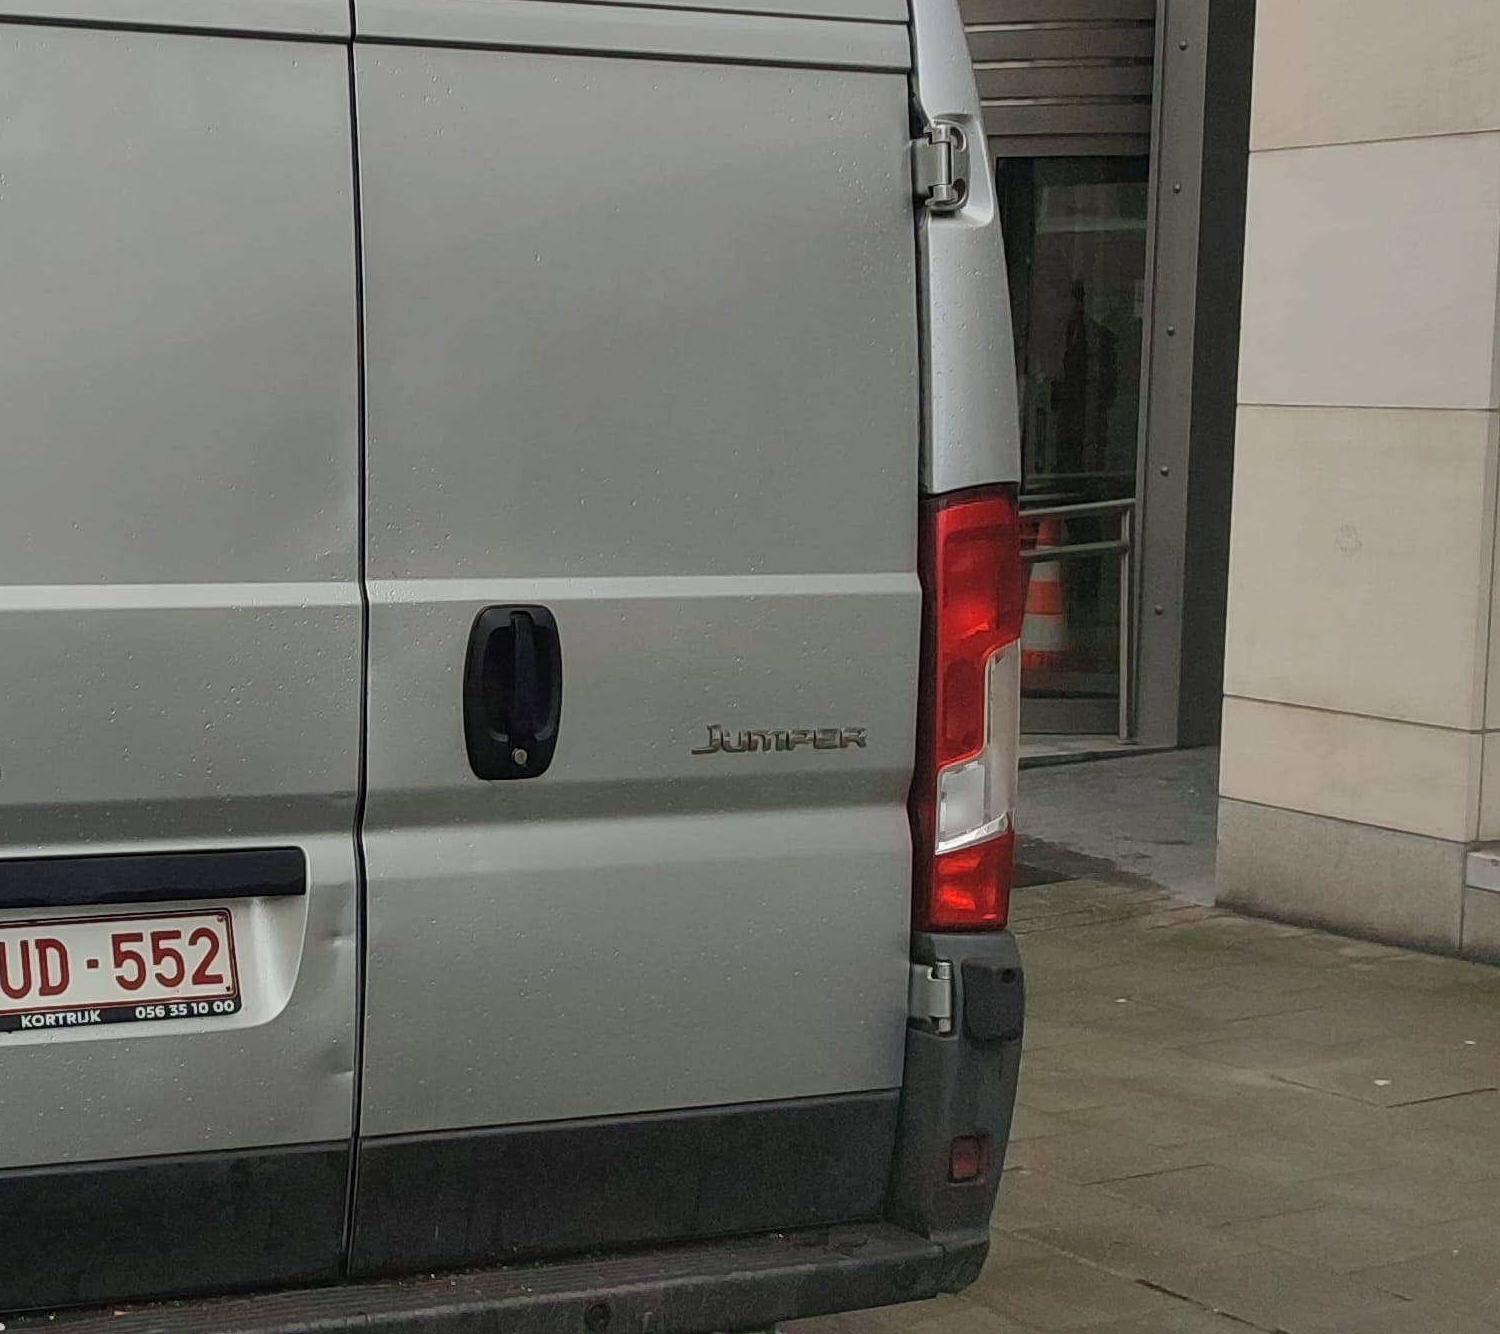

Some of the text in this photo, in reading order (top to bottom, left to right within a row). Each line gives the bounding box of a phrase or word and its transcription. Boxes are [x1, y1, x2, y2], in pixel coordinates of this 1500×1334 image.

[21, 1010, 101, 1028] KORTRIJK
[135, 1004, 166, 1019] 056
[169, 1003, 188, 1017] 35
[191, 1002, 209, 1015] 10
[213, 1000, 235, 1013] 00
